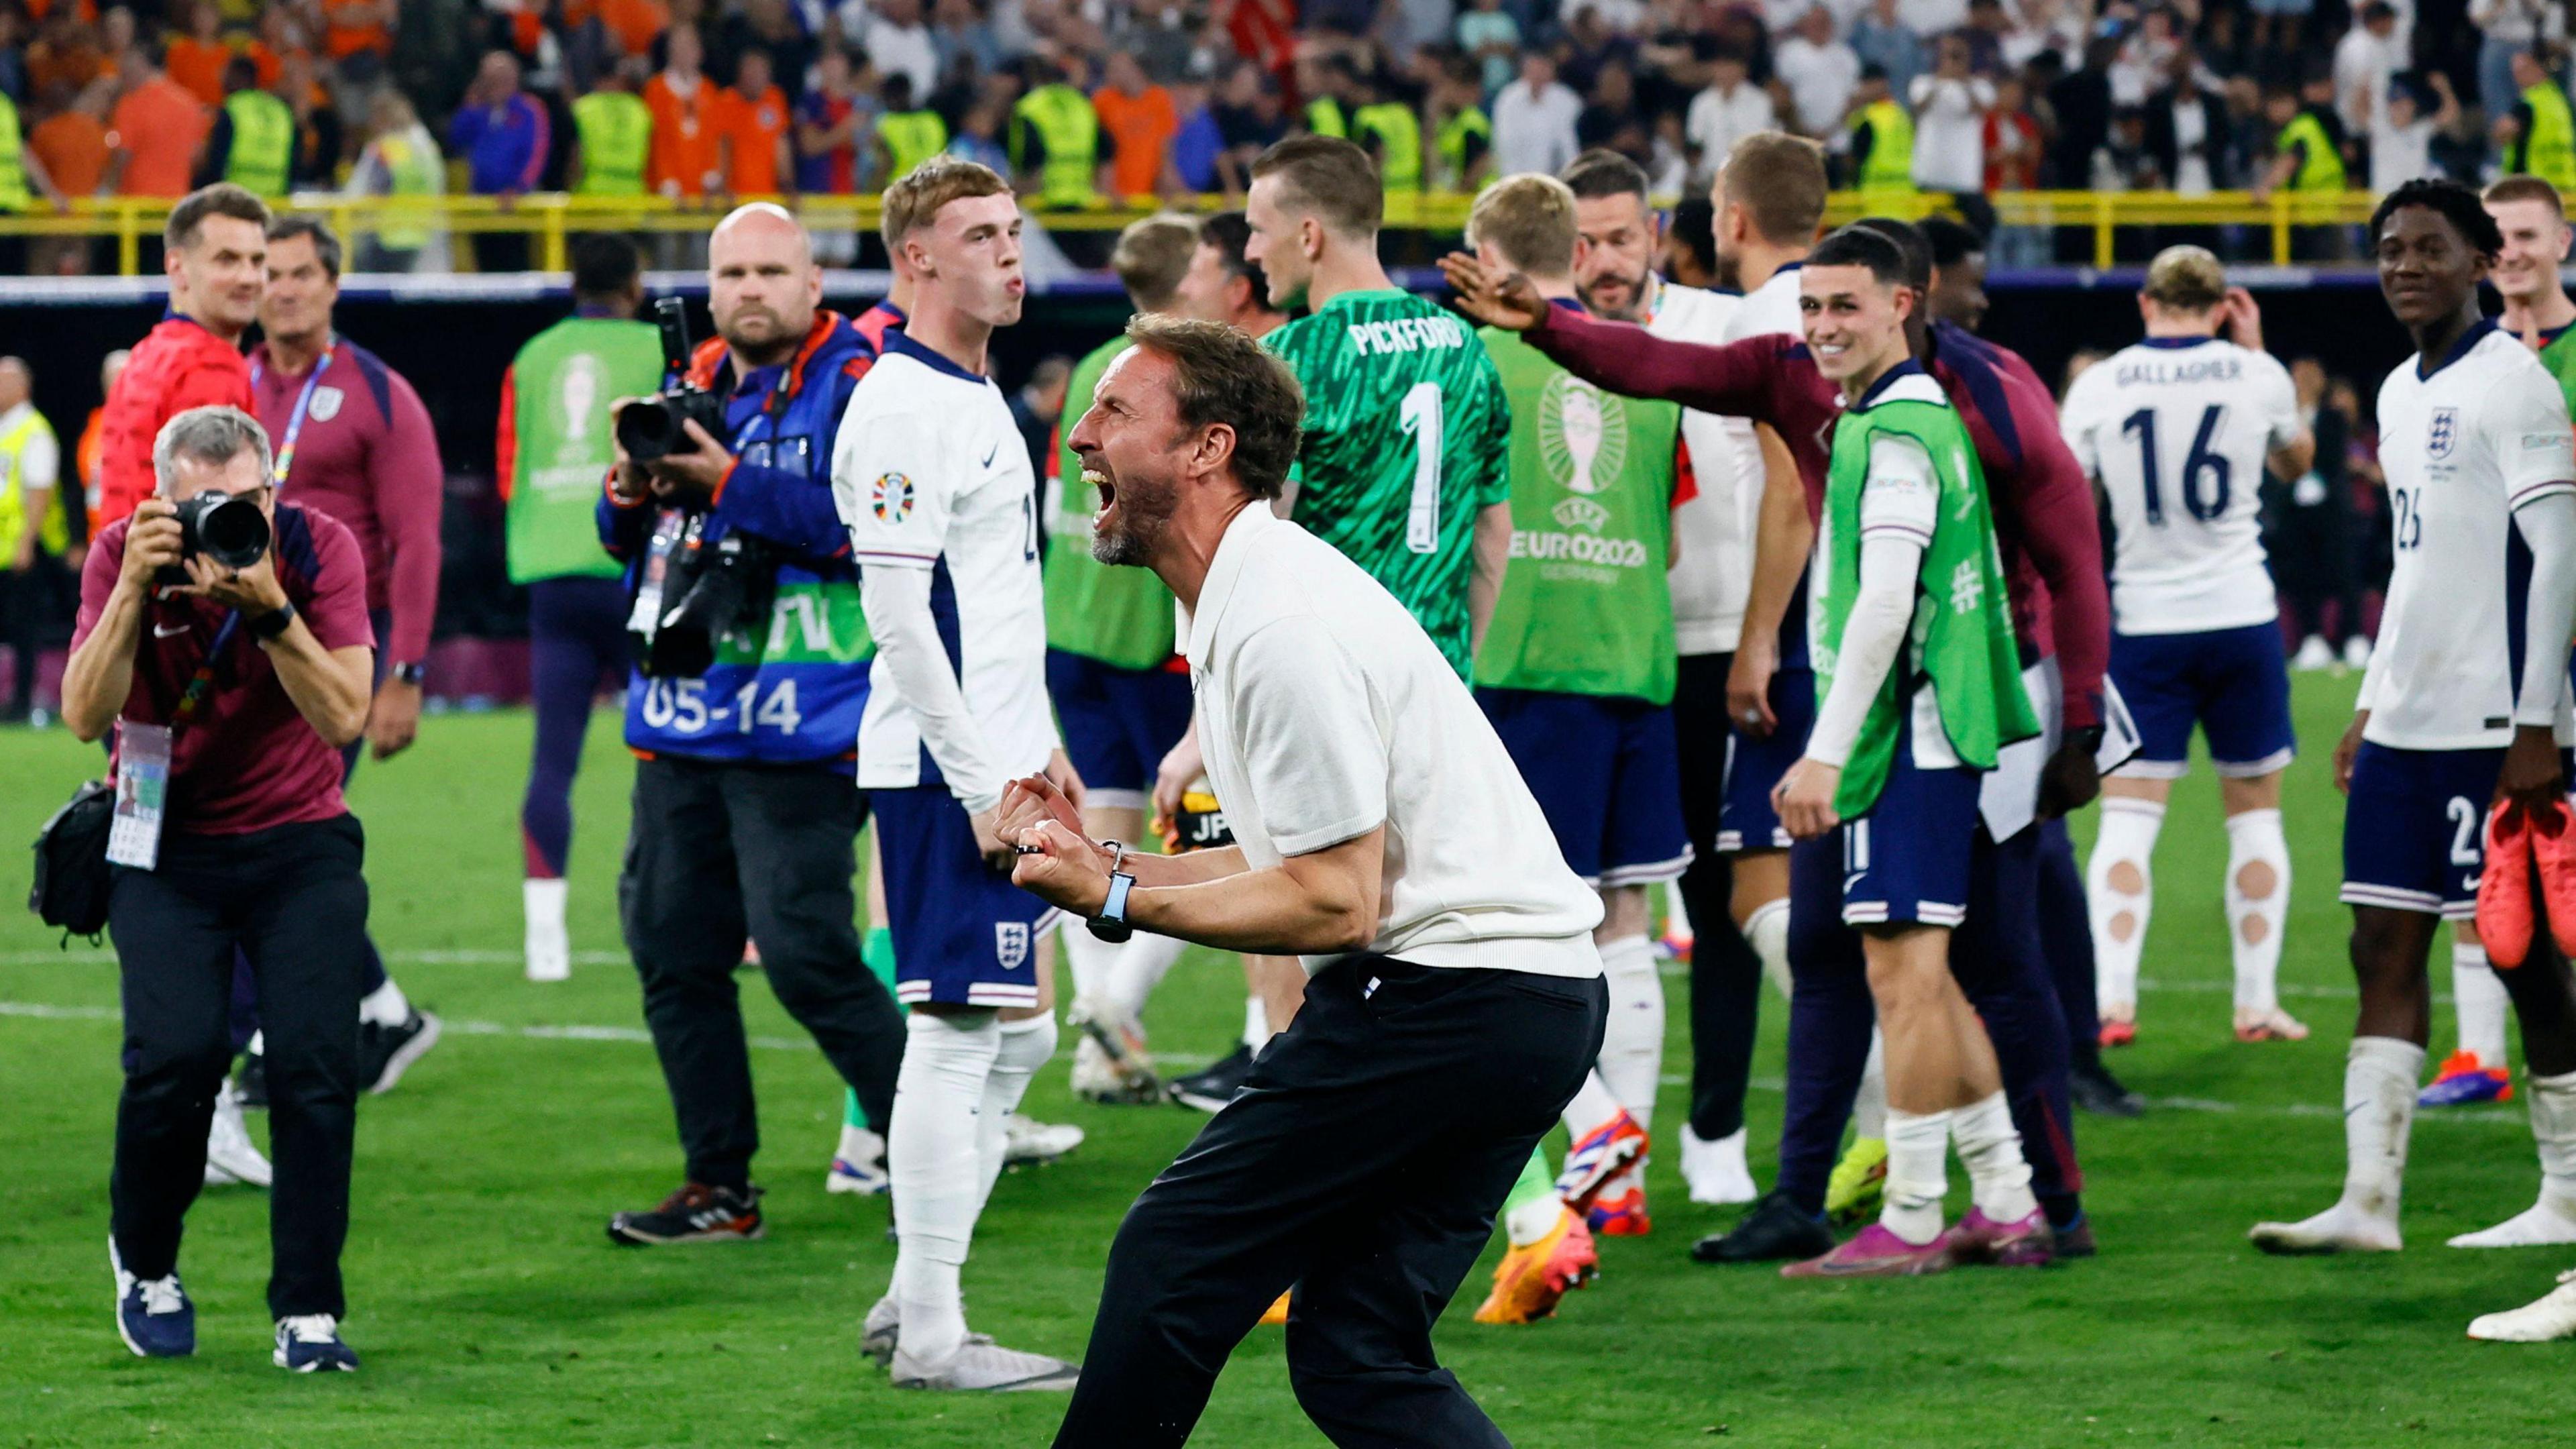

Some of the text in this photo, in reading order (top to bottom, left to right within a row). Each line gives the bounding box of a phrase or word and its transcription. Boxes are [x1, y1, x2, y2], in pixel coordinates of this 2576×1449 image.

[1400, 381, 1443, 554] 1
[2122, 404, 2231, 526] 16
[643, 678, 802, 735] 05-14
